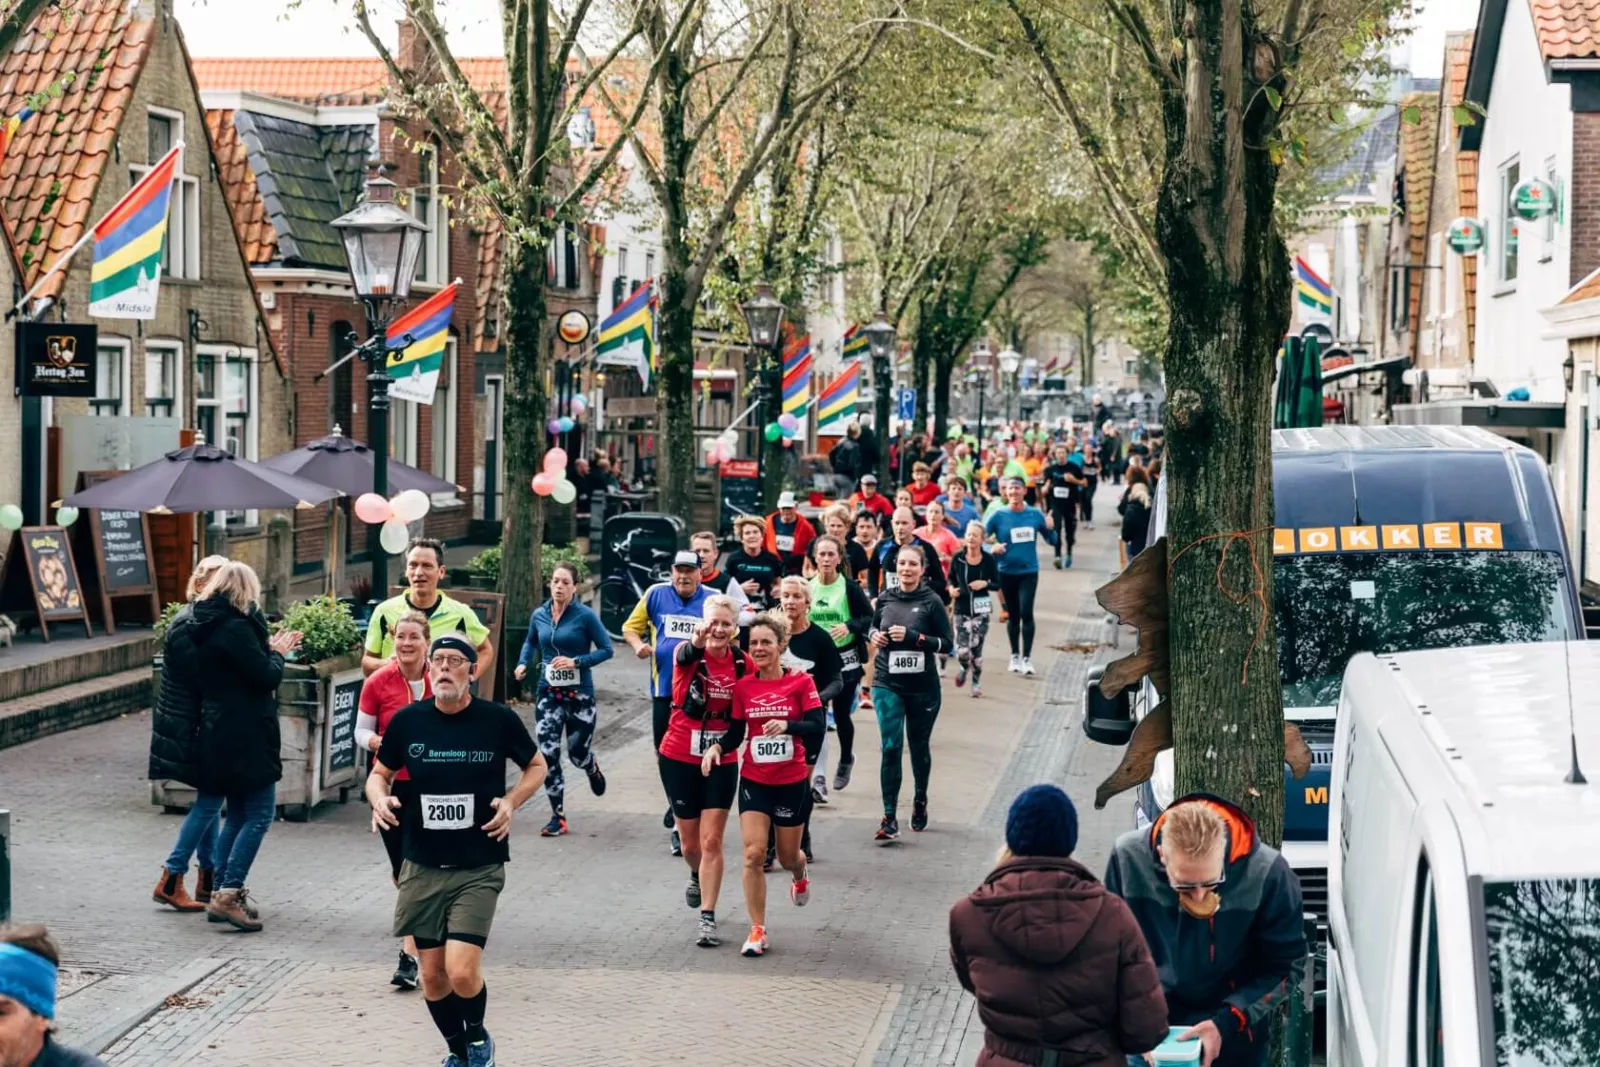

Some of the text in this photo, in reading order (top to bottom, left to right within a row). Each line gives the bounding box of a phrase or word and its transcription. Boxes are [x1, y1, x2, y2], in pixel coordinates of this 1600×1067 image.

[35, 366, 86, 380] Hertog Jan
[894, 656, 918, 668] 4897
[550, 670, 575, 681] 3395
[428, 749, 467, 759] Berenloop
[471, 751, 495, 762] 2017
[757, 742, 786, 756] 5021
[428, 804, 466, 821] 2300
